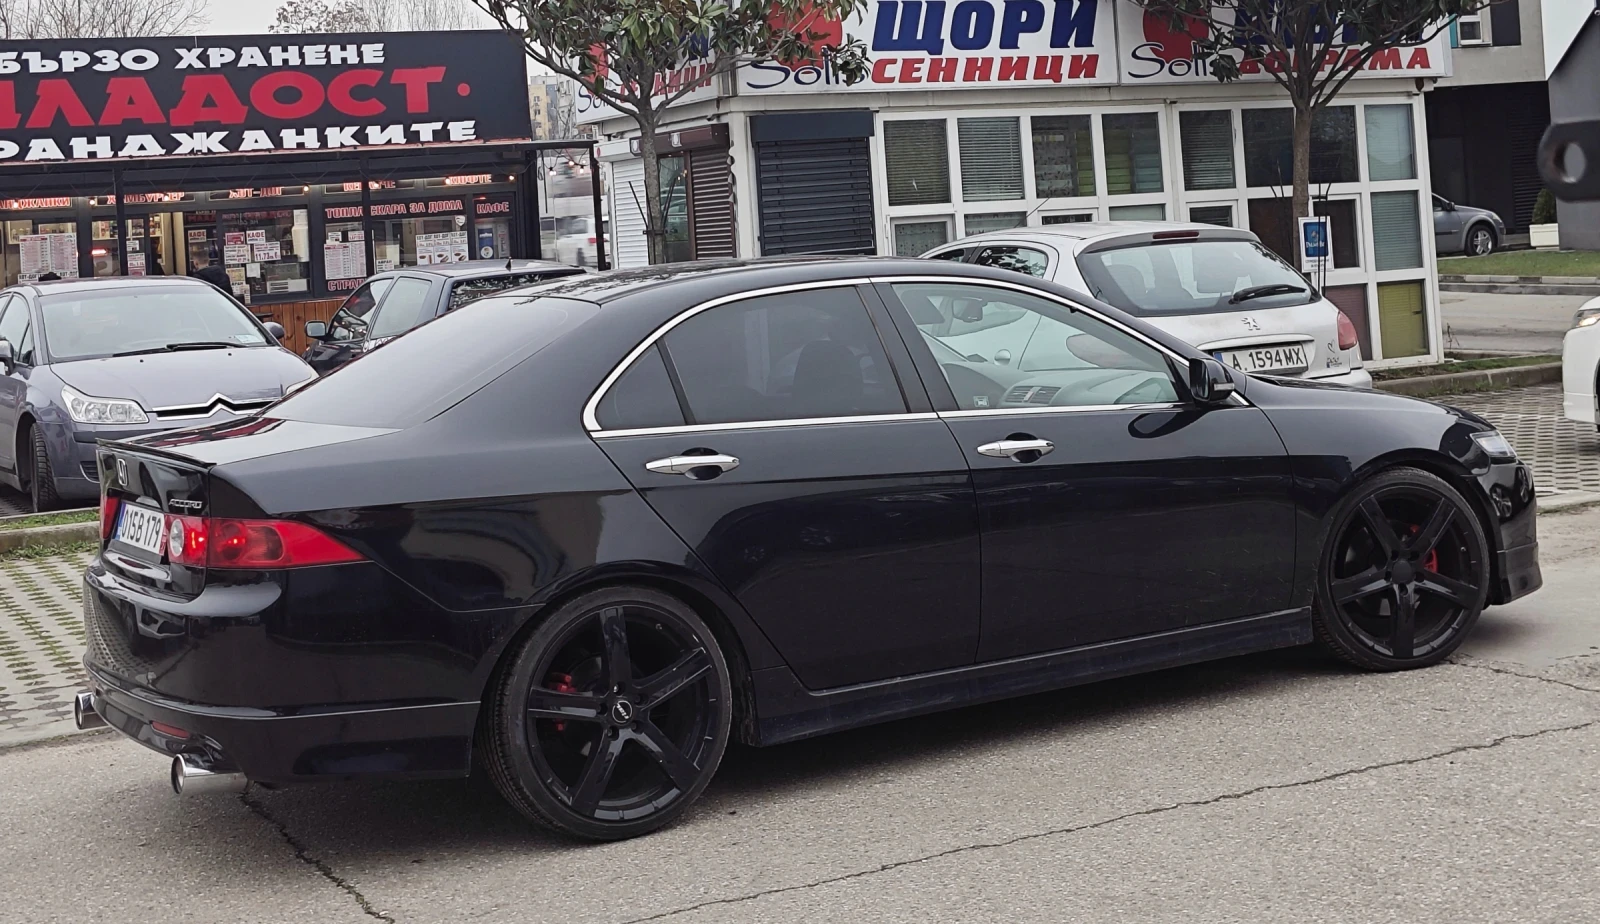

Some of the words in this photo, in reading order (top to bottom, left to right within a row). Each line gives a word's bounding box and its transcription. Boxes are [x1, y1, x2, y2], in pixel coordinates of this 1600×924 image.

[872, 0, 1099, 55] ЩОРИ
[0, 48, 160, 75] БЪРЗО
[174, 43, 385, 69] ХРАНЕНЕ
[746, 46, 866, 89] Sol
[871, 54, 1099, 84] СЕННИЦИ
[1128, 41, 1232, 79] Soli
[1239, 47, 1431, 74] ДОРАМА
[620, 62, 713, 104] СНИЦИ
[107, 192, 184, 204] ХМБУРЕР
[371, 203, 406, 216] СКАРА
[409, 202, 425, 213] ЗА
[428, 200, 463, 213] ДОМА
[476, 202, 509, 214] КАФЕ
[247, 231, 265, 239] КАФЕ
[169, 498, 203, 509] ACCORD
